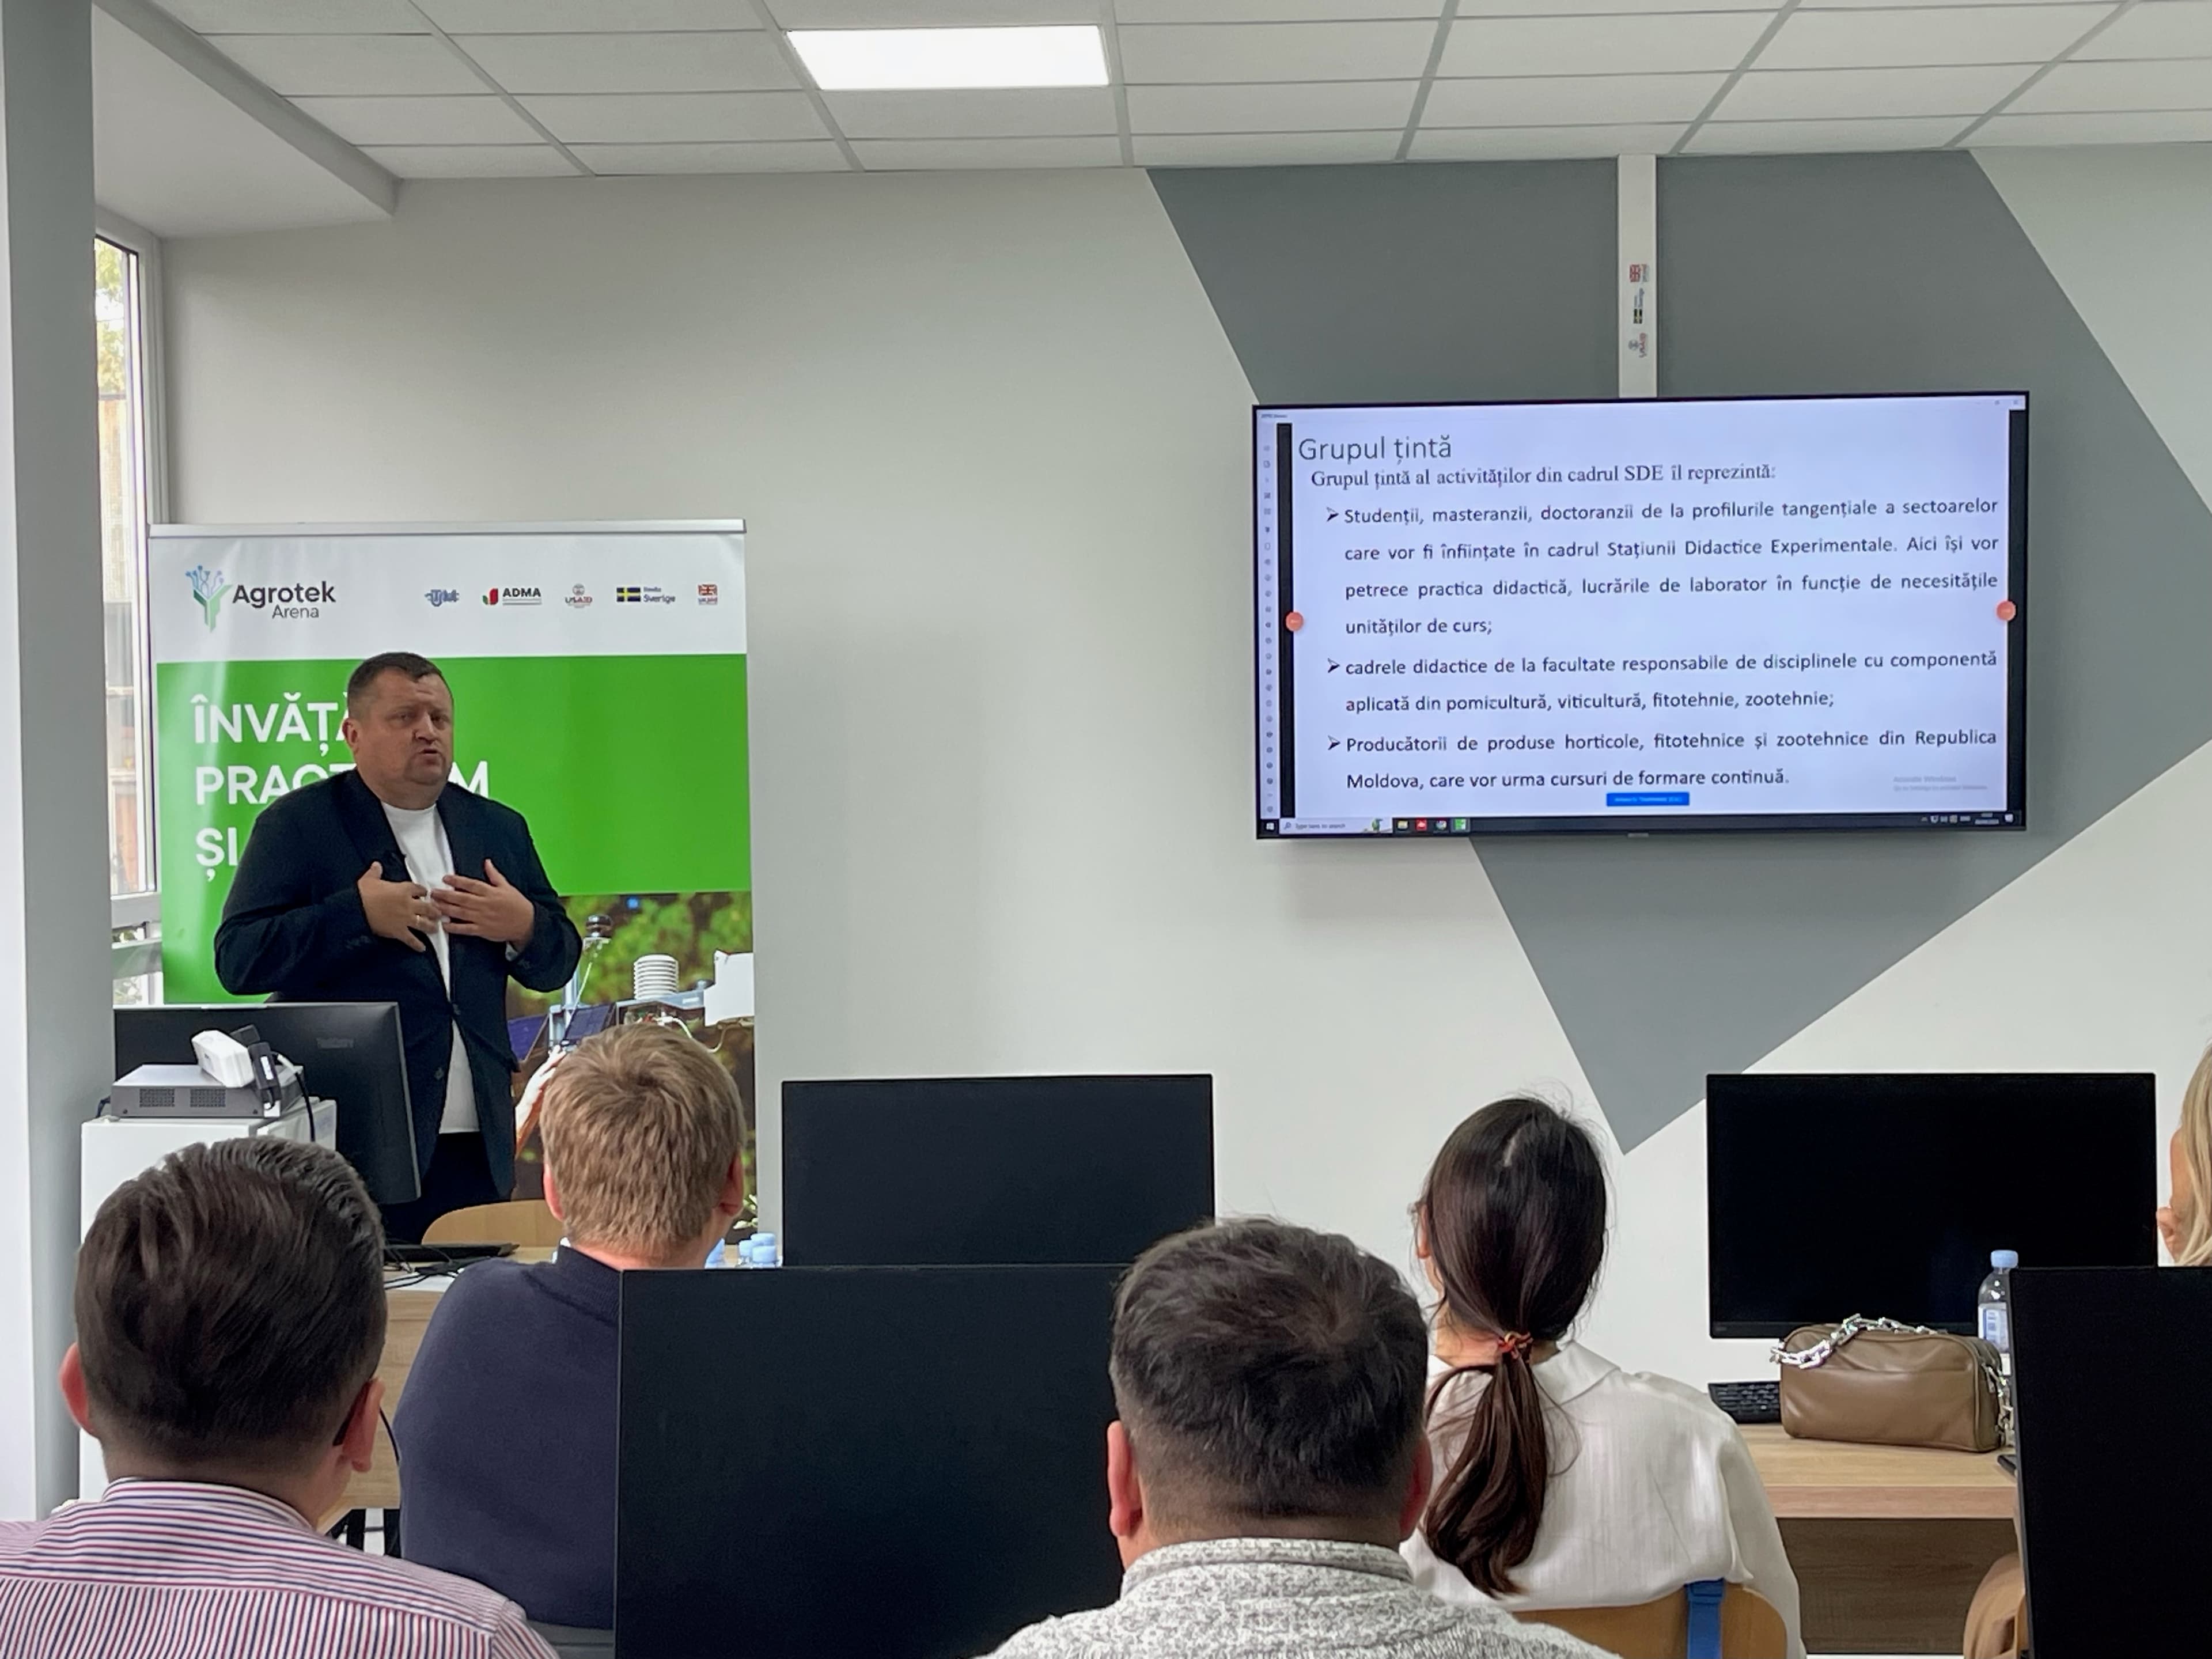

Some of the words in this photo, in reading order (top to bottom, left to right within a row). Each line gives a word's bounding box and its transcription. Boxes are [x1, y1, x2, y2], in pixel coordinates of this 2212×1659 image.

[1298, 435, 1385, 465] Grupul
[1310, 469, 1369, 491] Grupul
[1415, 468, 1430, 485] al
[1536, 466, 1563, 483] din
[1567, 465, 1619, 482] cadrul
[1624, 464, 1664, 481] SDE
[1671, 464, 1682, 480] îl
[1433, 505, 1532, 523] masteranzii,
[1540, 505, 1634, 520] doctoranzii
[1641, 503, 1662, 518] de
[1671, 502, 1684, 518] la
[1692, 501, 1774, 521] profilurile
[1885, 503, 1895, 514] a
[1902, 497, 1998, 514] sectoarelor
[1344, 549, 1380, 560] care
[1388, 548, 1415, 560] vor
[1423, 543, 1433, 559] fi
[1524, 541, 1539, 558] în
[1547, 541, 1599, 557] cadrul
[1685, 539, 1763, 555] Didactice
[1771, 536, 1897, 557] Experimentale.
[1906, 536, 1937, 552] Aici
[1971, 539, 1999, 551] vor
[232, 581, 336, 608] Agrotek
[502, 588, 541, 597] ADMA
[1346, 584, 1408, 601] petrece
[1418, 581, 1483, 600] practica
[1493, 578, 1573, 597] didactică,
[1582, 577, 1650, 594] lucrările
[1659, 577, 1681, 593] de
[1690, 576, 1768, 592] laborator
[1776, 574, 1792, 591] în
[1870, 573, 1892, 589] de
[272, 604, 320, 619] Arena
[1427, 617, 1448, 633] de
[1453, 620, 1492, 635] curs;
[1346, 658, 1406, 675] cadrele
[1413, 658, 1488, 674] didactice
[1494, 657, 1515, 673] de
[1521, 657, 1536, 672] la
[1542, 656, 1616, 672] facultate
[1622, 654, 1729, 675] responsabile
[1736, 654, 1757, 670] de
[1763, 652, 1857, 672] disciplinele
[1864, 656, 1884, 668] cu
[1890, 650, 1997, 671] componentă
[1346, 695, 1410, 715] aplicată
[1415, 695, 1441, 711] din
[1446, 693, 1552, 714] pomicultură,
[1557, 692, 1646, 711] viticultură,
[1653, 691, 1739, 709] fitotehnie,
[1745, 690, 1834, 707] zootehnie;
[191, 691, 349, 757] ÎNVĂȚ
[1347, 736, 1447, 752] Producătorii
[1457, 735, 1478, 751] de
[1487, 734, 1555, 753] produse
[1565, 733, 1645, 751] horticole,
[1653, 732, 1745, 748] fitotehnice
[1776, 730, 1869, 747] zootehnice
[1879, 730, 1905, 745] din
[1915, 729, 1997, 748] Republica
[1347, 772, 1424, 791] Moldova,
[1429, 776, 1465, 787] care
[1469, 775, 1498, 787] vor
[1502, 775, 1545, 787] urma
[1550, 771, 1607, 786] cursuri
[1612, 770, 1634, 786] de
[1638, 770, 1706, 785] formare
